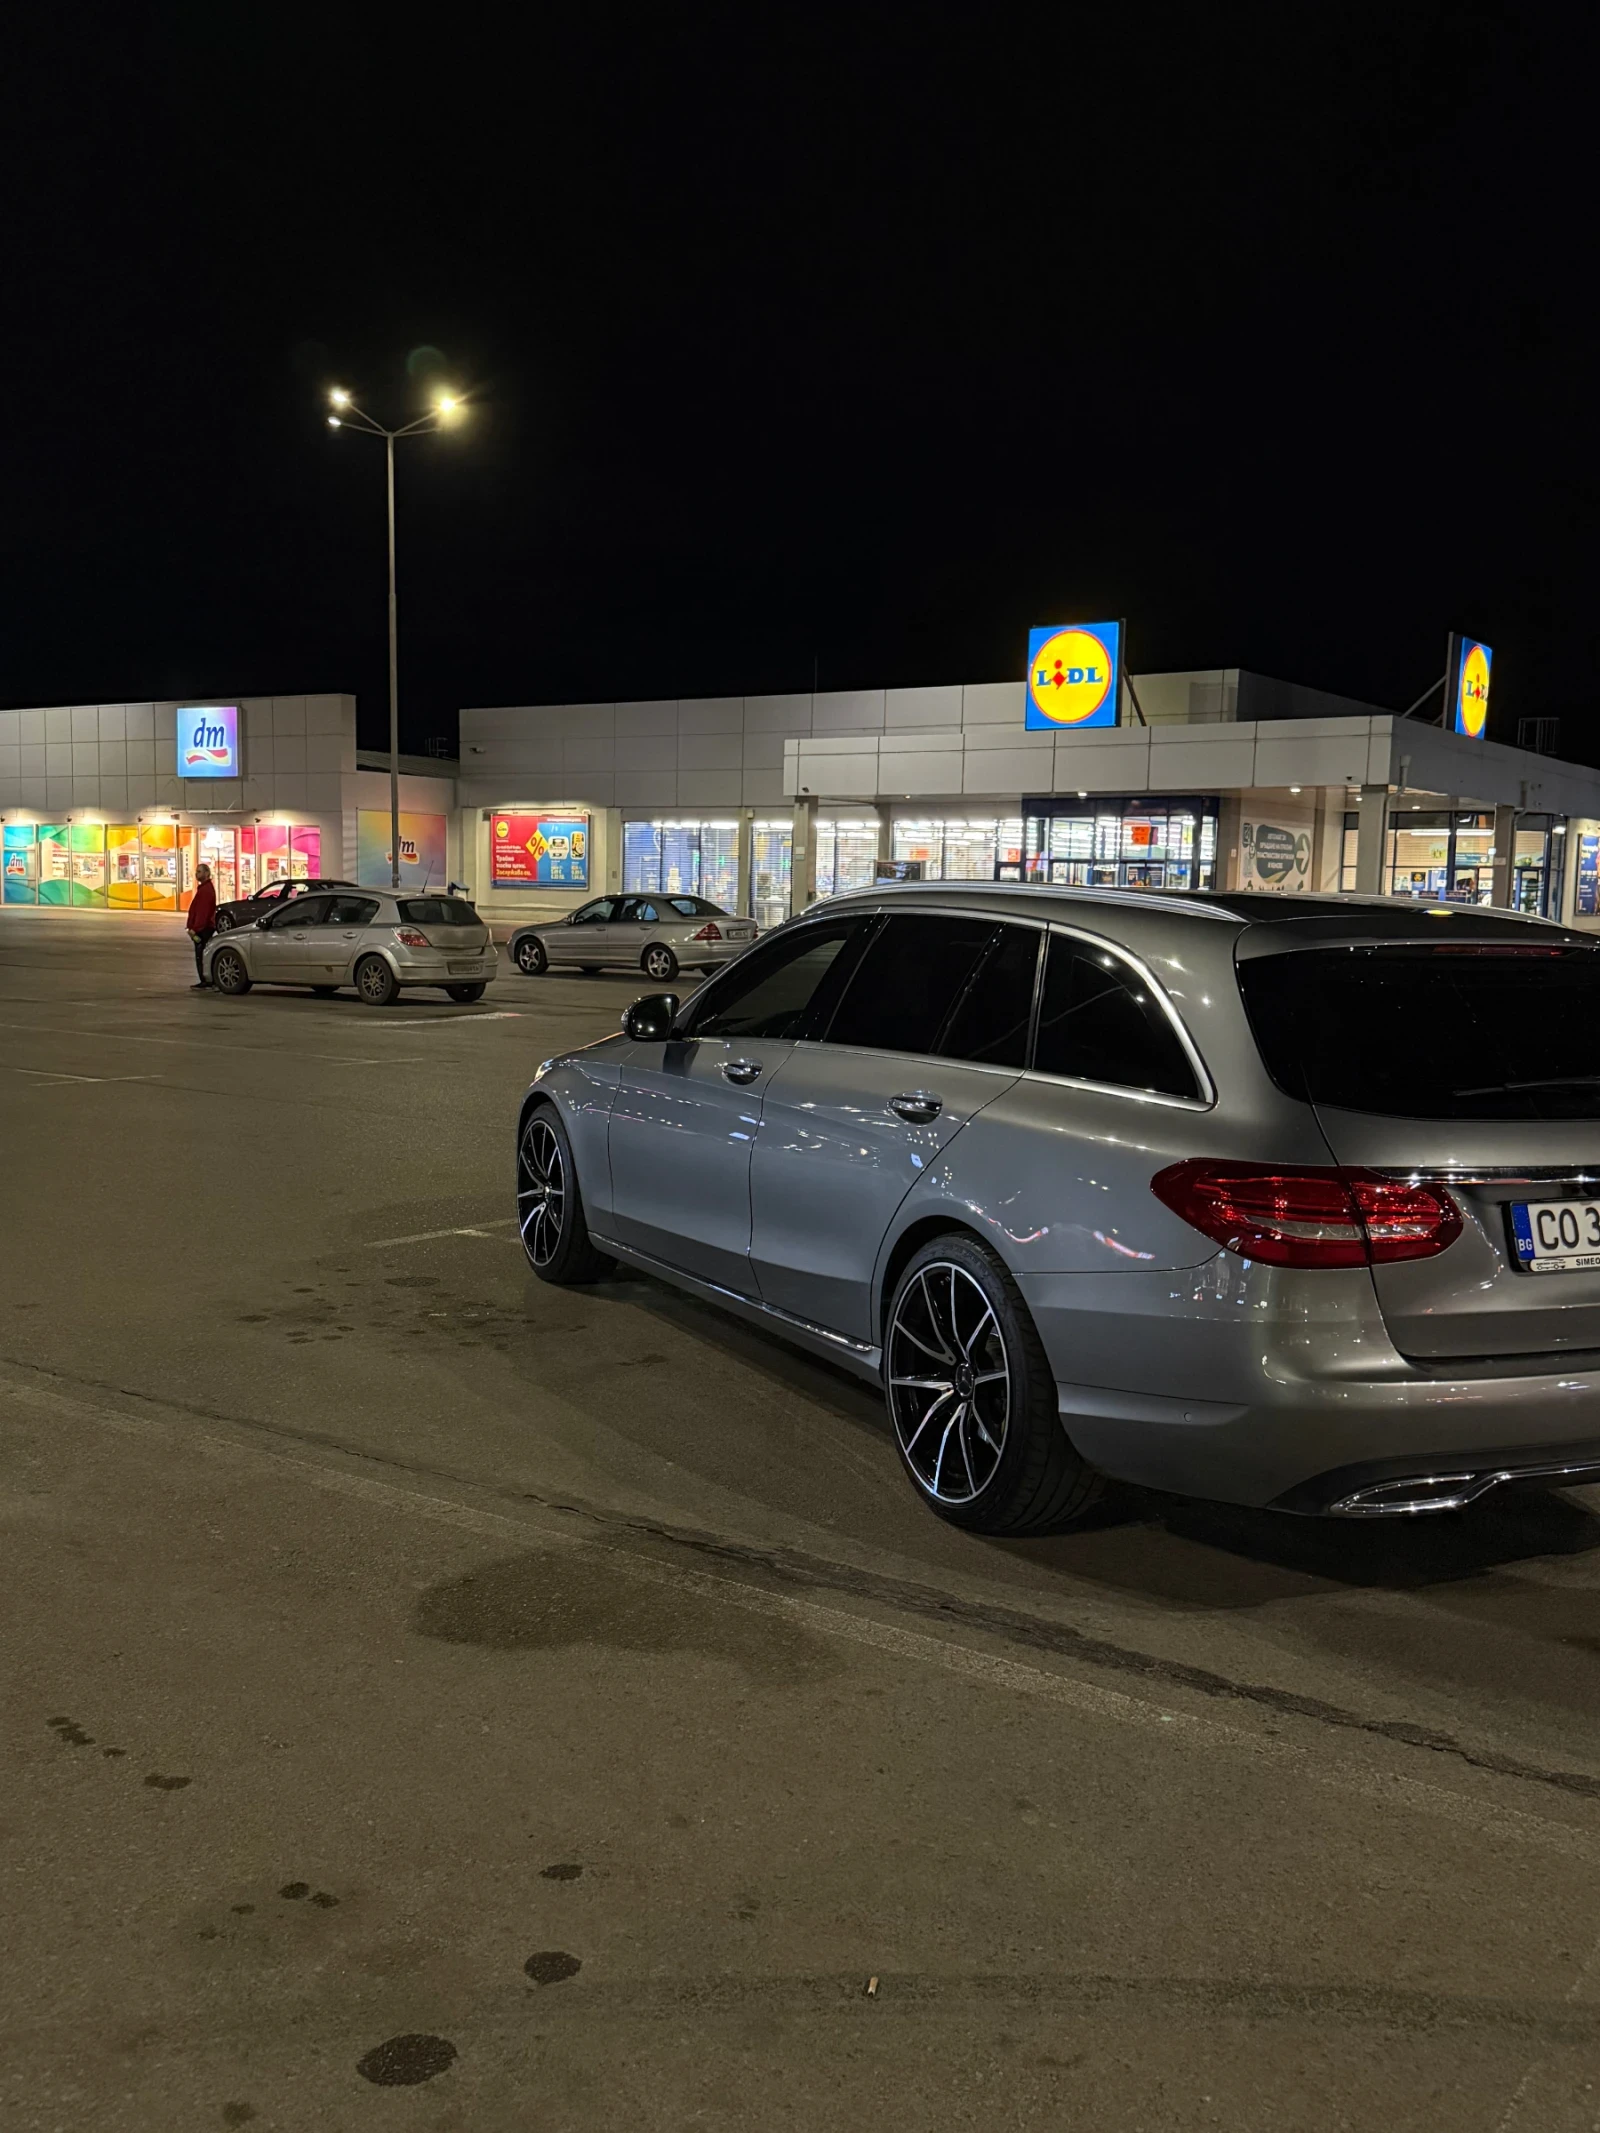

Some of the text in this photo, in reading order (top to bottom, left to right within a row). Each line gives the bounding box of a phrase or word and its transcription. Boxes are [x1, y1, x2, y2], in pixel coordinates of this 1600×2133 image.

[194, 717, 225, 748] dm
[10, 854, 23, 867] dm
[1518, 1239, 1533, 1251] BG
